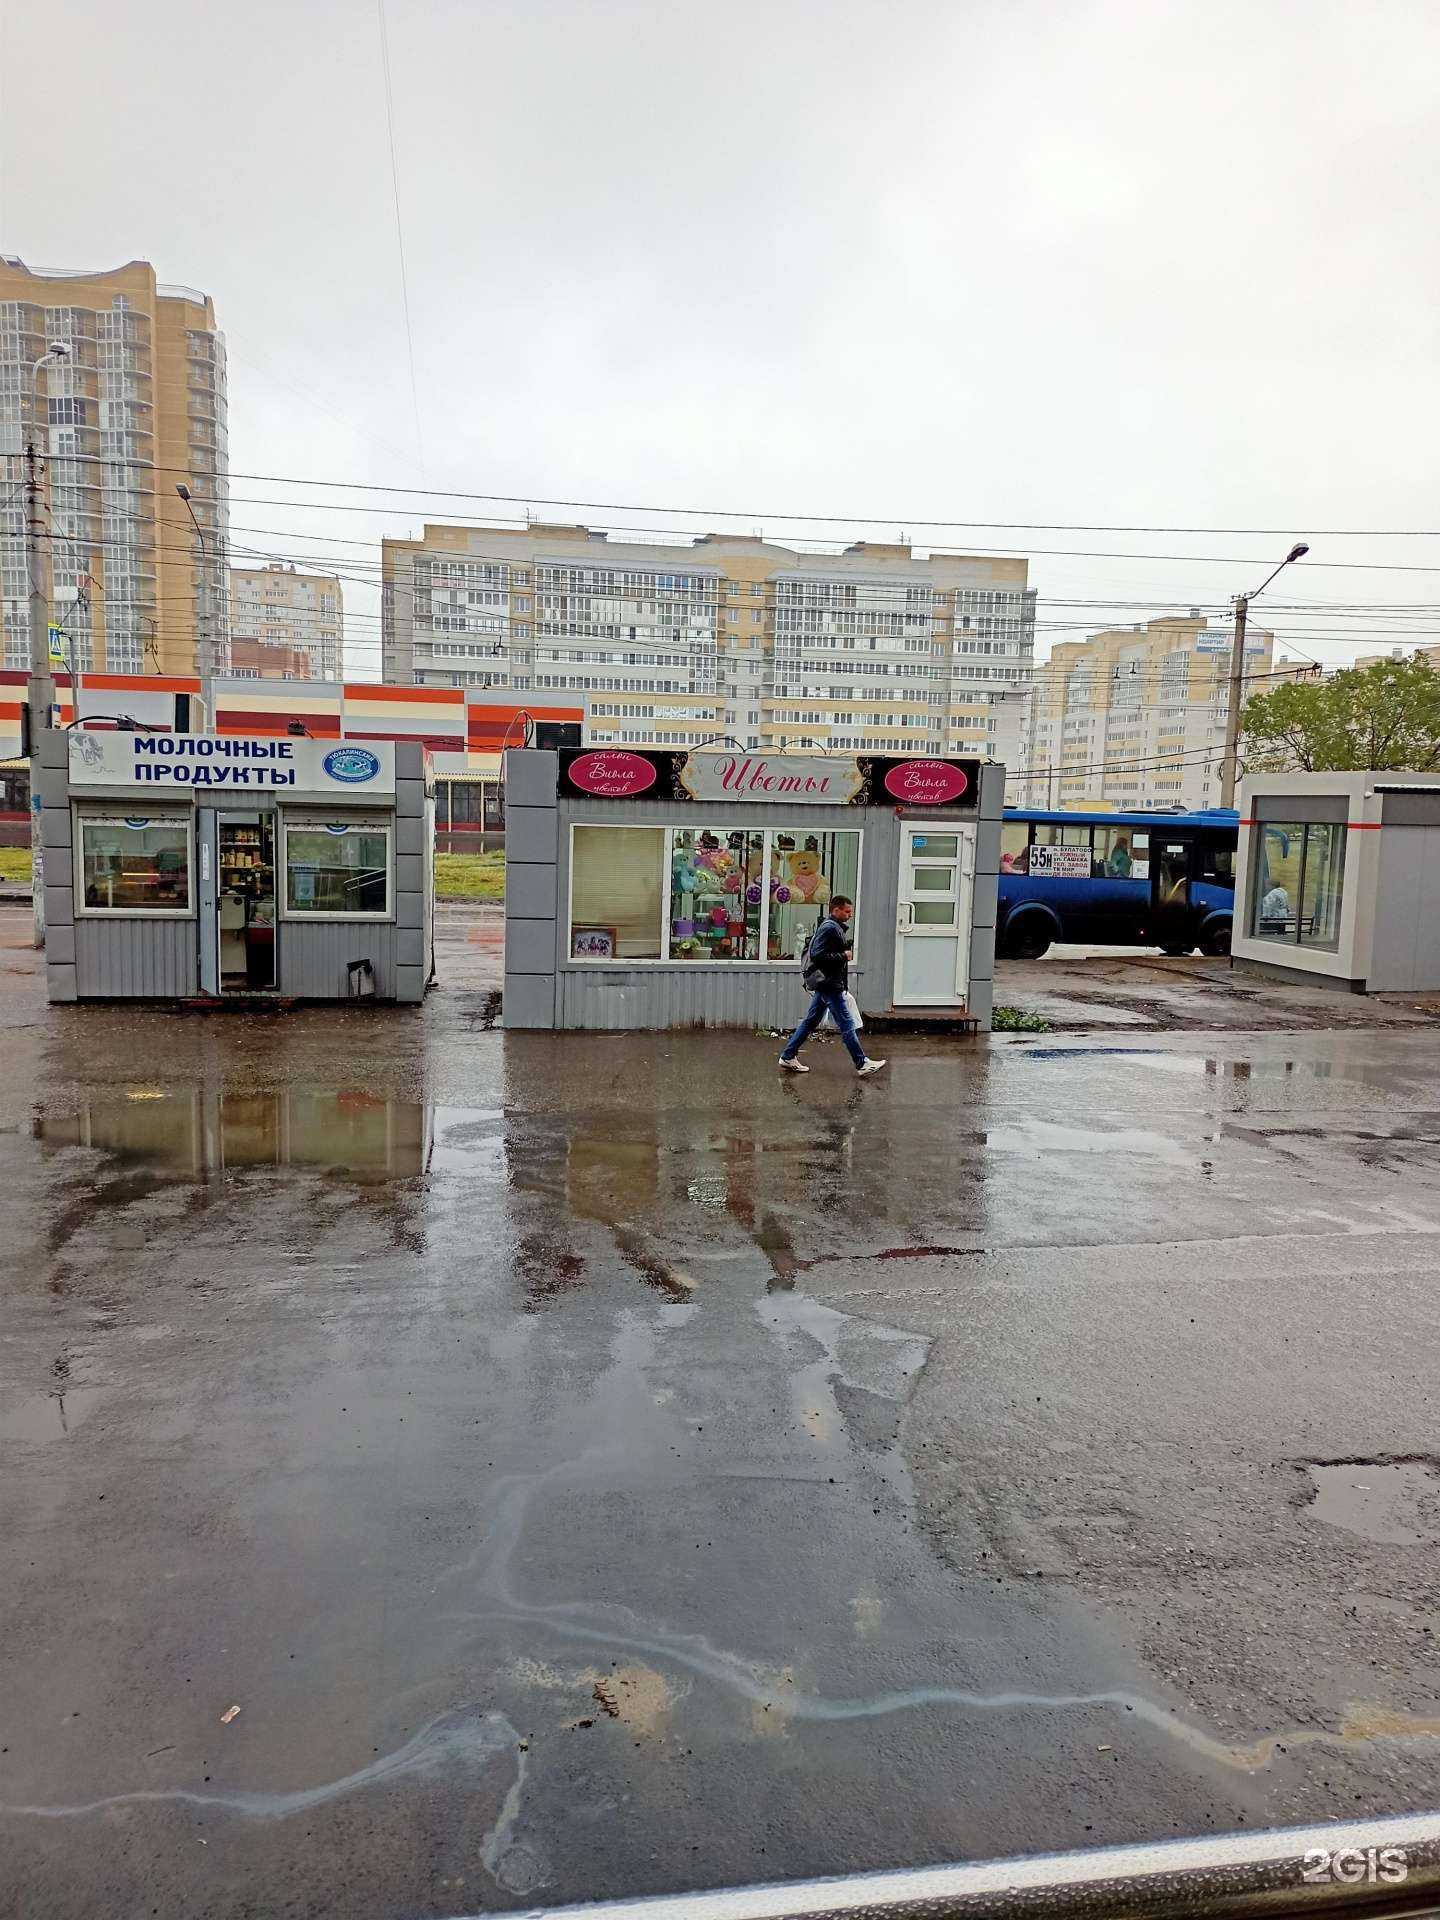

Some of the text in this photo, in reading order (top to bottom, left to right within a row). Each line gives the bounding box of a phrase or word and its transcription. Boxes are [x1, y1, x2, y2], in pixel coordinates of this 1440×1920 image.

[134, 737, 294, 759] МОЛОЧНЫЕ
[594, 753, 632, 761] салон
[589, 763, 636, 779] Виола
[909, 762, 945, 770] салон
[135, 764, 295, 785] ПРОДУКТЫ
[714, 756, 829, 798] Цветы
[904, 772, 948, 788] Виола
[593, 782, 631, 792] цветов
[908, 790, 943, 800] цветов
